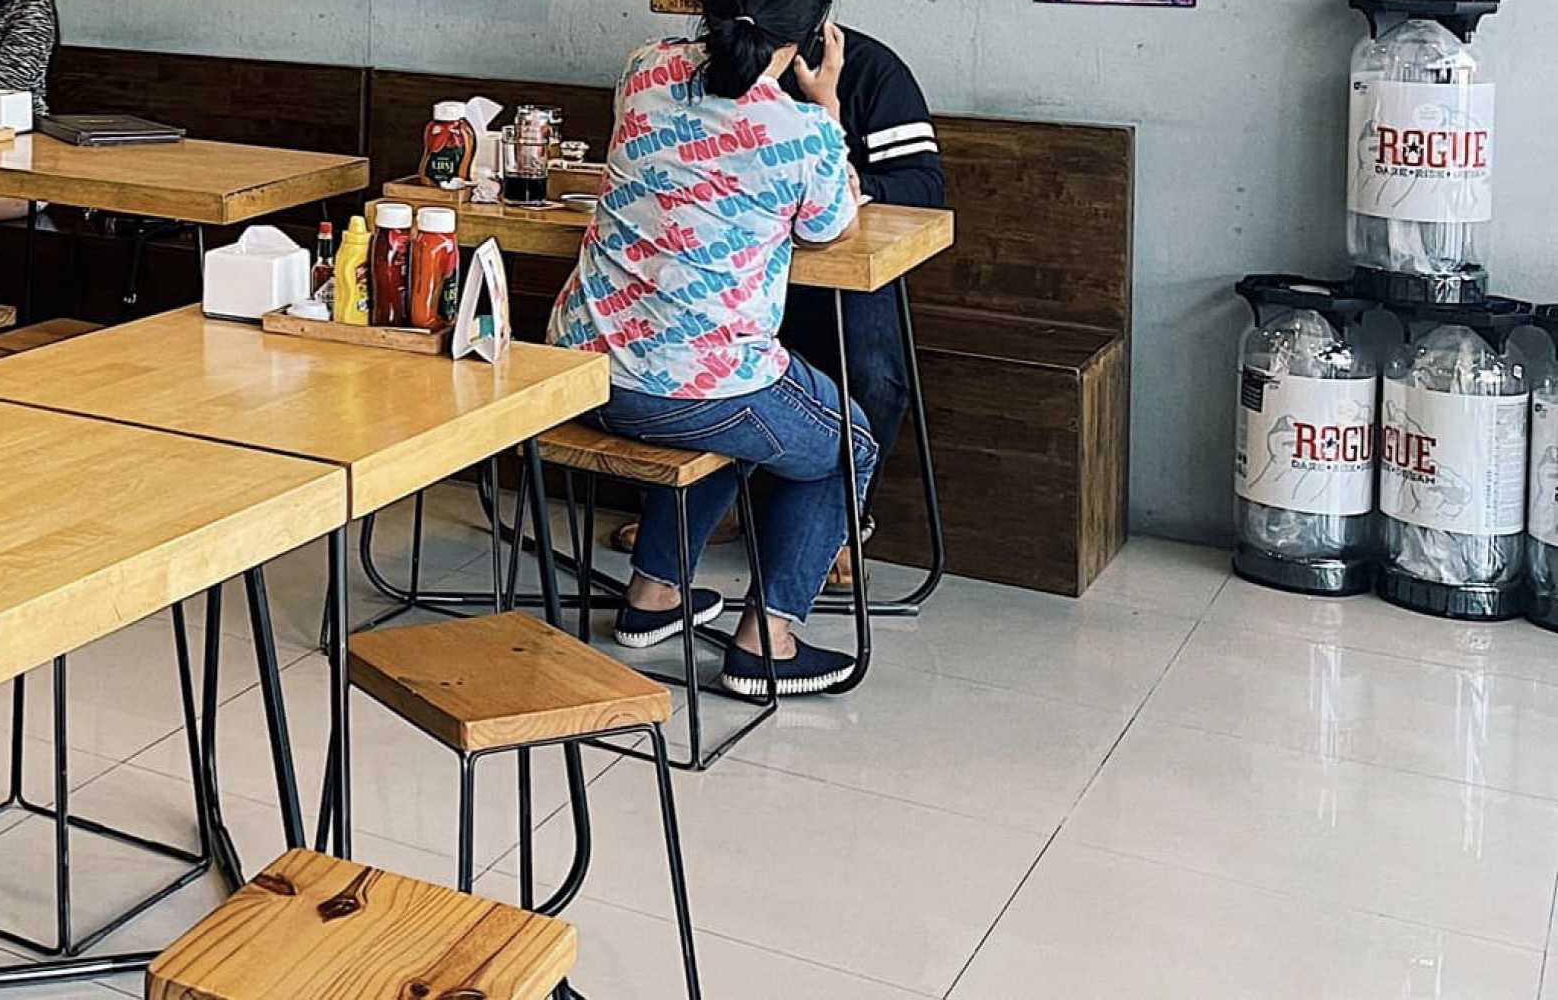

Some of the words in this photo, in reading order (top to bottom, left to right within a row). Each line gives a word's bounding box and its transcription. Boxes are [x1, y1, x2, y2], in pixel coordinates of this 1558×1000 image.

[625, 113, 707, 160] UNIQUE
[677, 117, 773, 163] UNIQUE
[1374, 126, 1488, 169] ROGUE
[1292, 422, 1374, 462] ROGU
[1384, 425, 1437, 475] GUE
